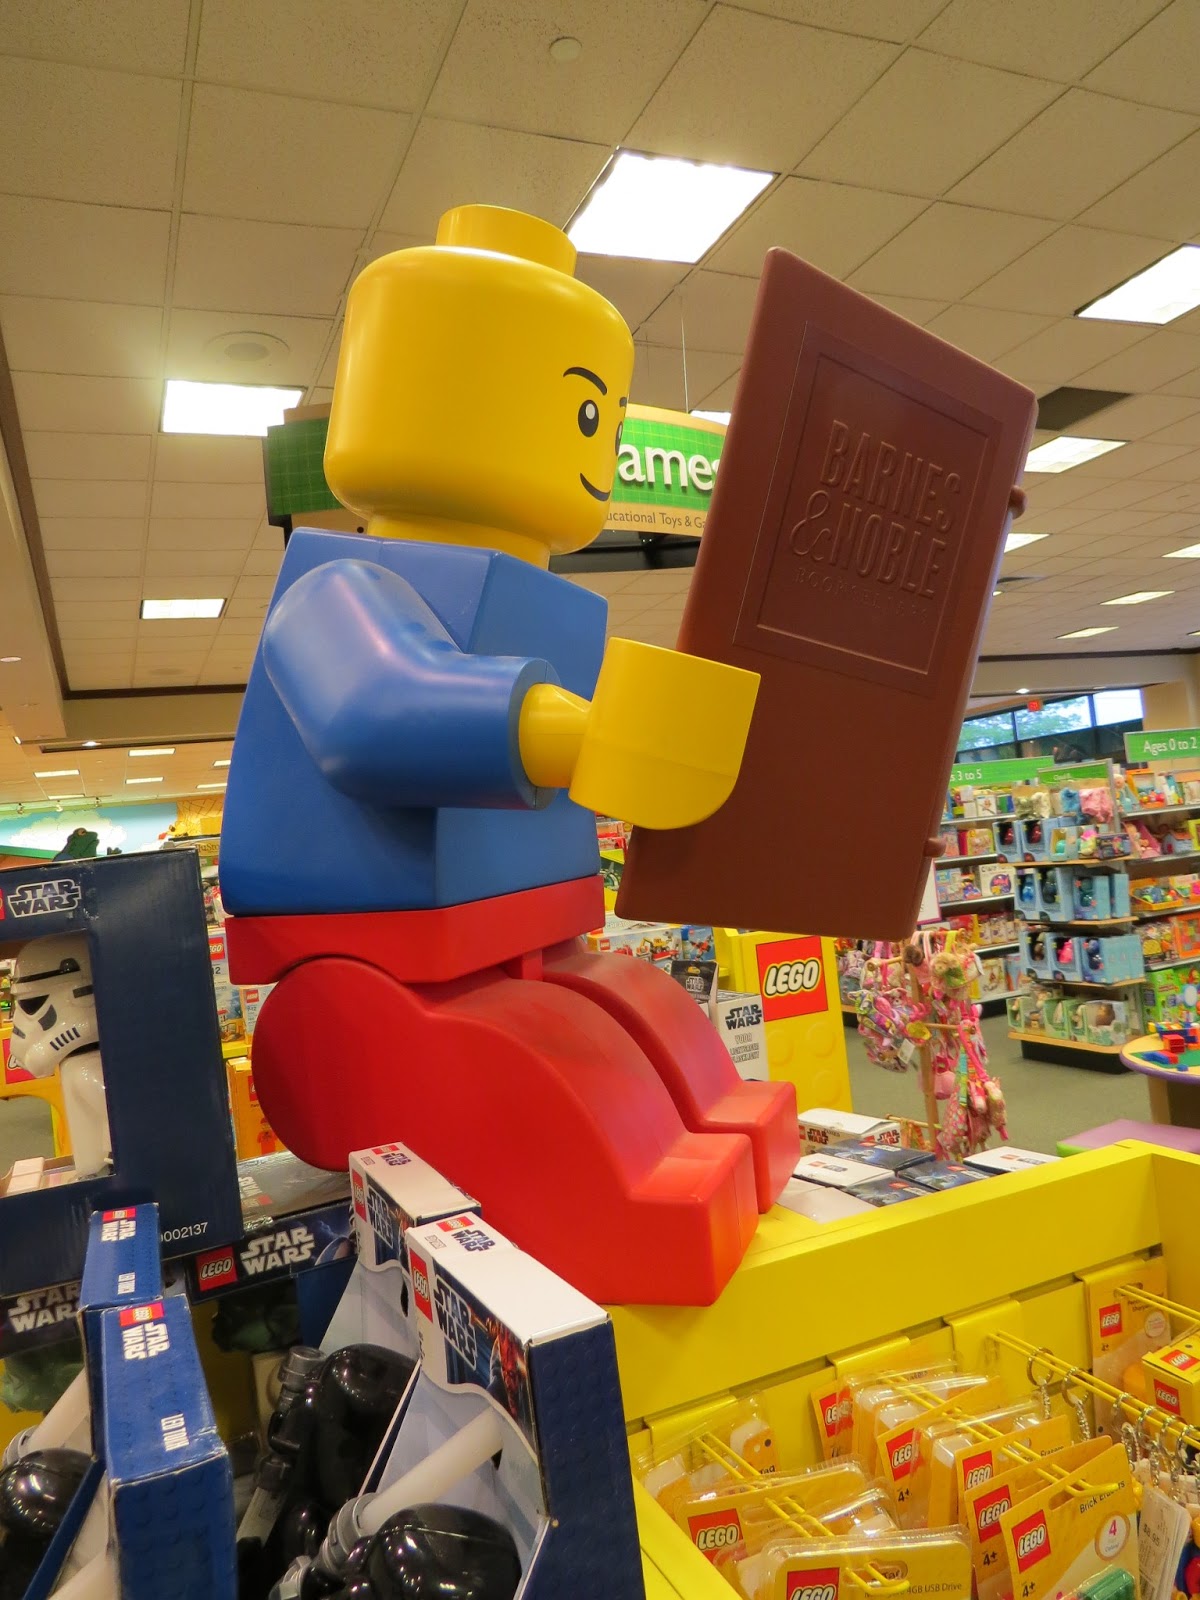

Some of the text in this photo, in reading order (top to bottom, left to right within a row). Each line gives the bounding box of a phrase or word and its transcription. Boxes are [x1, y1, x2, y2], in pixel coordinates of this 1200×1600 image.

[820, 419, 961, 533] BARNES
[659, 512, 682, 528] Toys
[684, 515, 692, 527] &
[789, 490, 947, 599] & NOBLE
[1143, 736, 1198, 756] Ages 0 to 2
[957, 770, 963, 781] 3
[965, 772, 975, 780] to
[976, 768, 982, 779] 5
[9, 880, 81, 899] STAR
[9, 895, 81, 917] WARS
[209, 943, 223, 954] EGO
[764, 958, 820, 997] LEGO
[725, 1004, 762, 1020] STAR
[726, 1014, 762, 1030] WARS
[102, 1221, 119, 1242] WARS
[119, 1220, 136, 1240] STAR
[464, 1229, 496, 1250] STAR
[451, 1231, 486, 1251] WARS
[201, 1227, 314, 1280] LEGO STAR
[241, 1241, 315, 1275] WARS
[413, 1267, 430, 1301] LEGO
[8, 1284, 80, 1317] STAR
[433, 1276, 476, 1339] STAR
[1102, 1313, 1120, 1328] LEGO
[122, 1325, 146, 1360] WARS
[144, 1322, 171, 1357] STAR
[434, 1299, 477, 1368] WARS
[1170, 1353, 1190, 1367] LEGO
[1157, 1387, 1177, 1405] LEGO
[967, 1464, 992, 1490] LEGO
[1080, 1481, 1125, 1514] Brick Erars
[980, 1498, 1009, 1529] LEGO
[698, 1524, 738, 1550] LEGO
[1109, 1519, 1118, 1536] 4
[1019, 1525, 1045, 1557] LEGO
[983, 1551, 998, 1566] 4+
[907, 1586, 923, 1595] 4GB
[924, 1583, 940, 1593] USB
[941, 1583, 962, 1592] Drive
[1022, 1582, 1036, 1598] 4+
